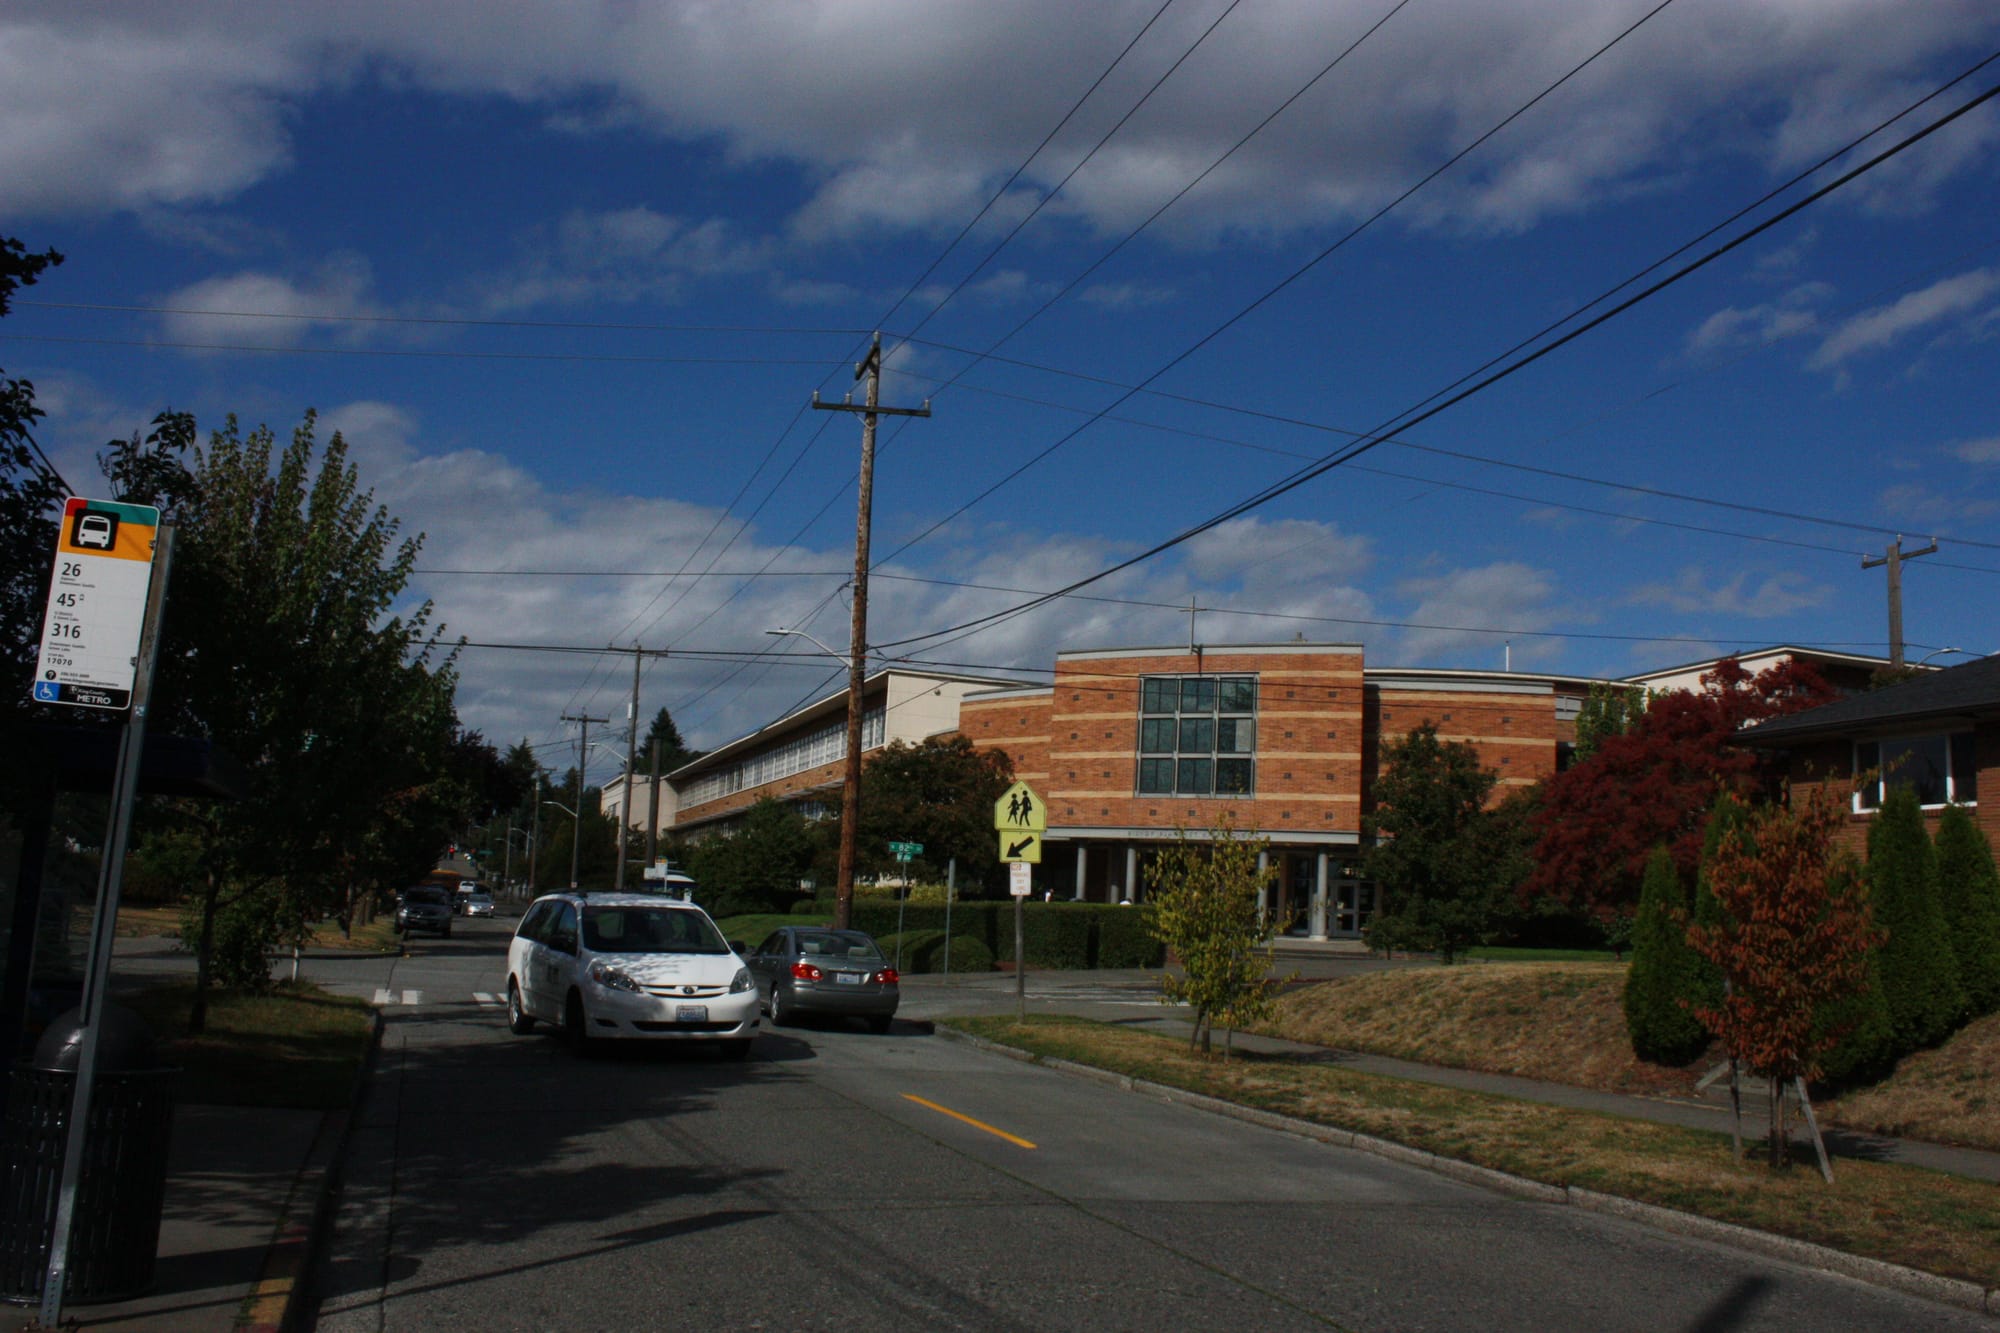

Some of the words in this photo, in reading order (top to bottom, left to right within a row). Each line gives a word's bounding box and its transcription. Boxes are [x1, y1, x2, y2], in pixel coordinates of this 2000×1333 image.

[61, 562, 81, 577] 26
[57, 592, 76, 607] 45
[51, 622, 81, 639] 316
[47, 657, 73, 666] 17070
[77, 694, 112, 705] METRO
